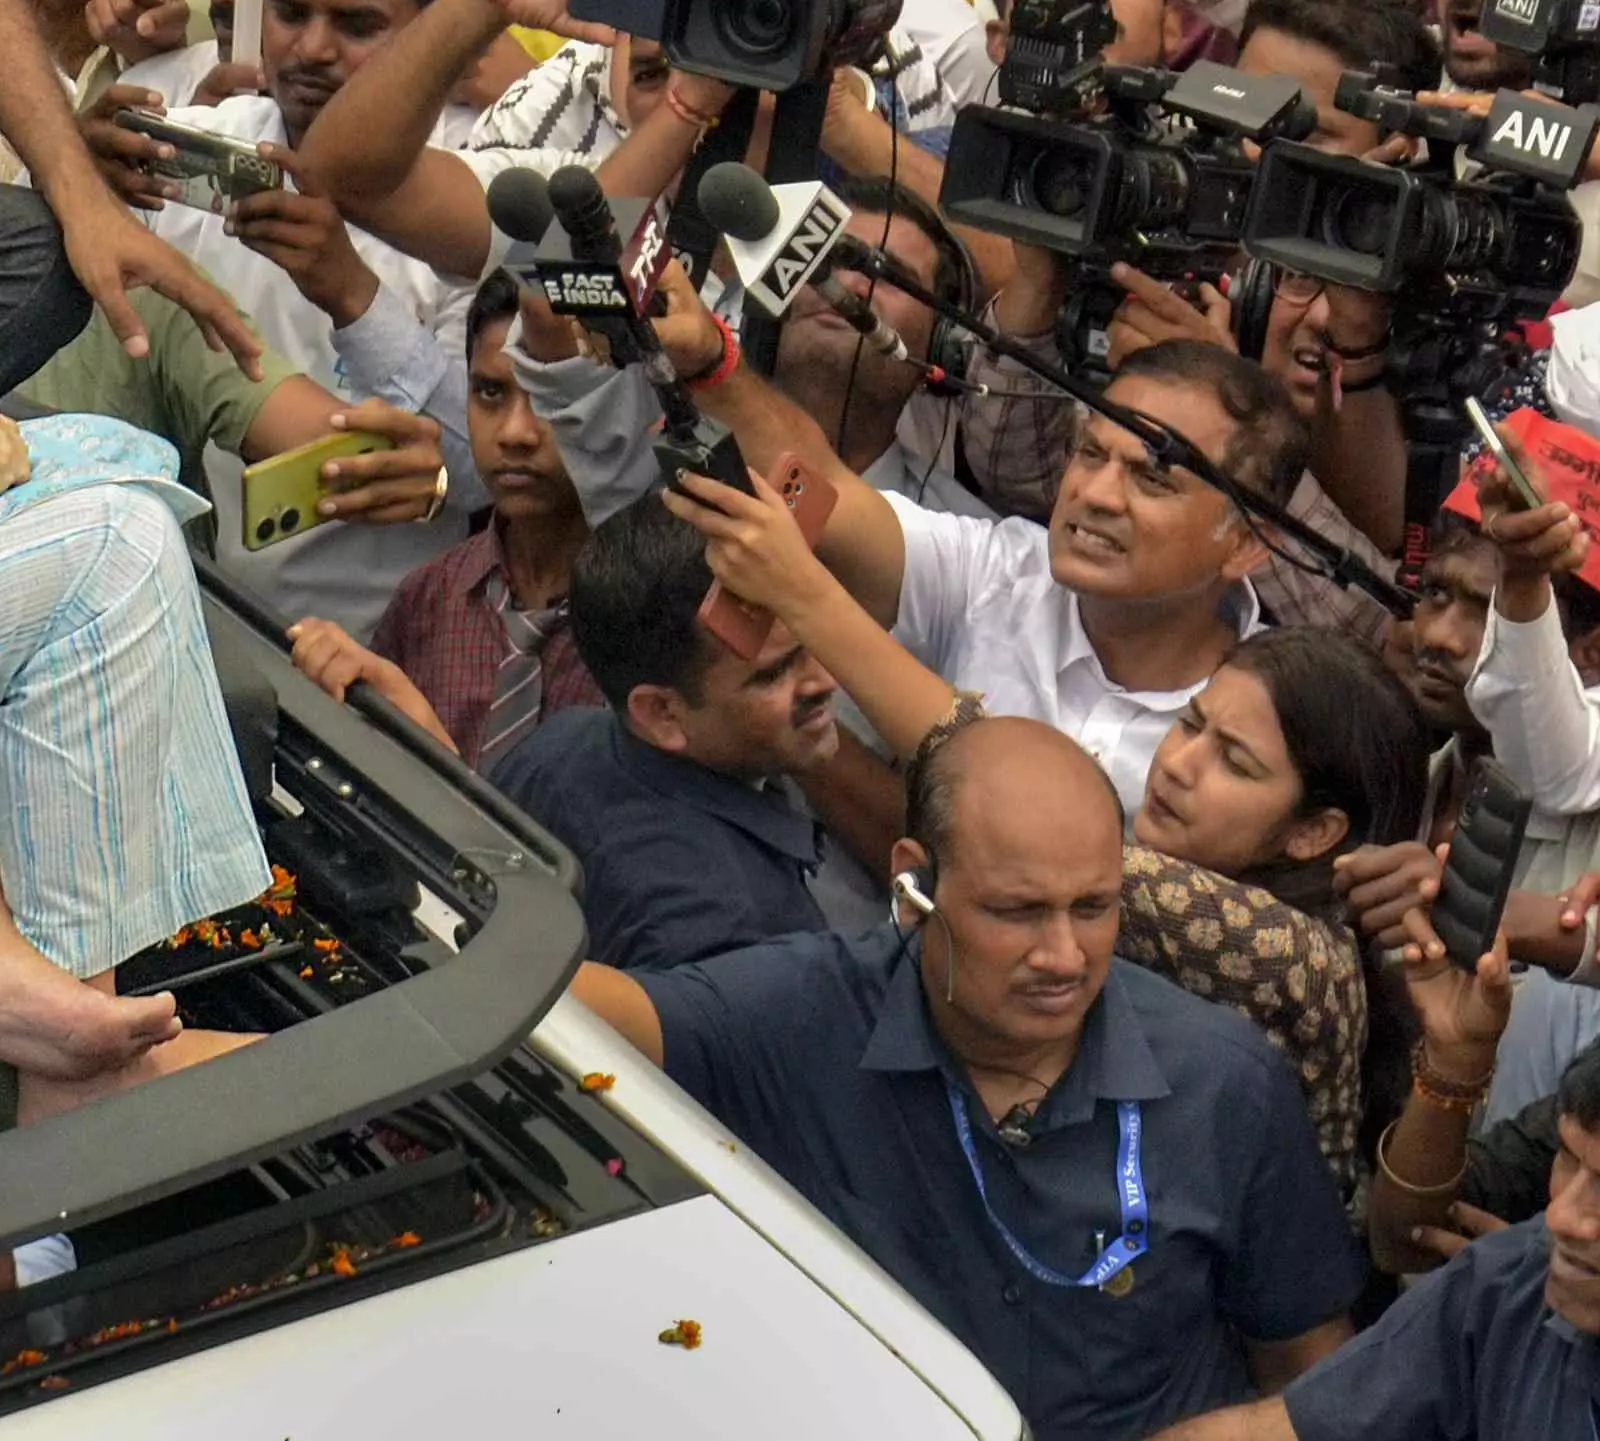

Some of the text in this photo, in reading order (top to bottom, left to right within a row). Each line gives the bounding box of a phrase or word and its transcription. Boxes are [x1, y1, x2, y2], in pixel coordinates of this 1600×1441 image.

[1492, 110, 1572, 160] ANI
[772, 201, 843, 297] ANI
[562, 273, 614, 290] FACT
[562, 288, 627, 307] INDIA
[1123, 1112, 1142, 1209] VIP Security
